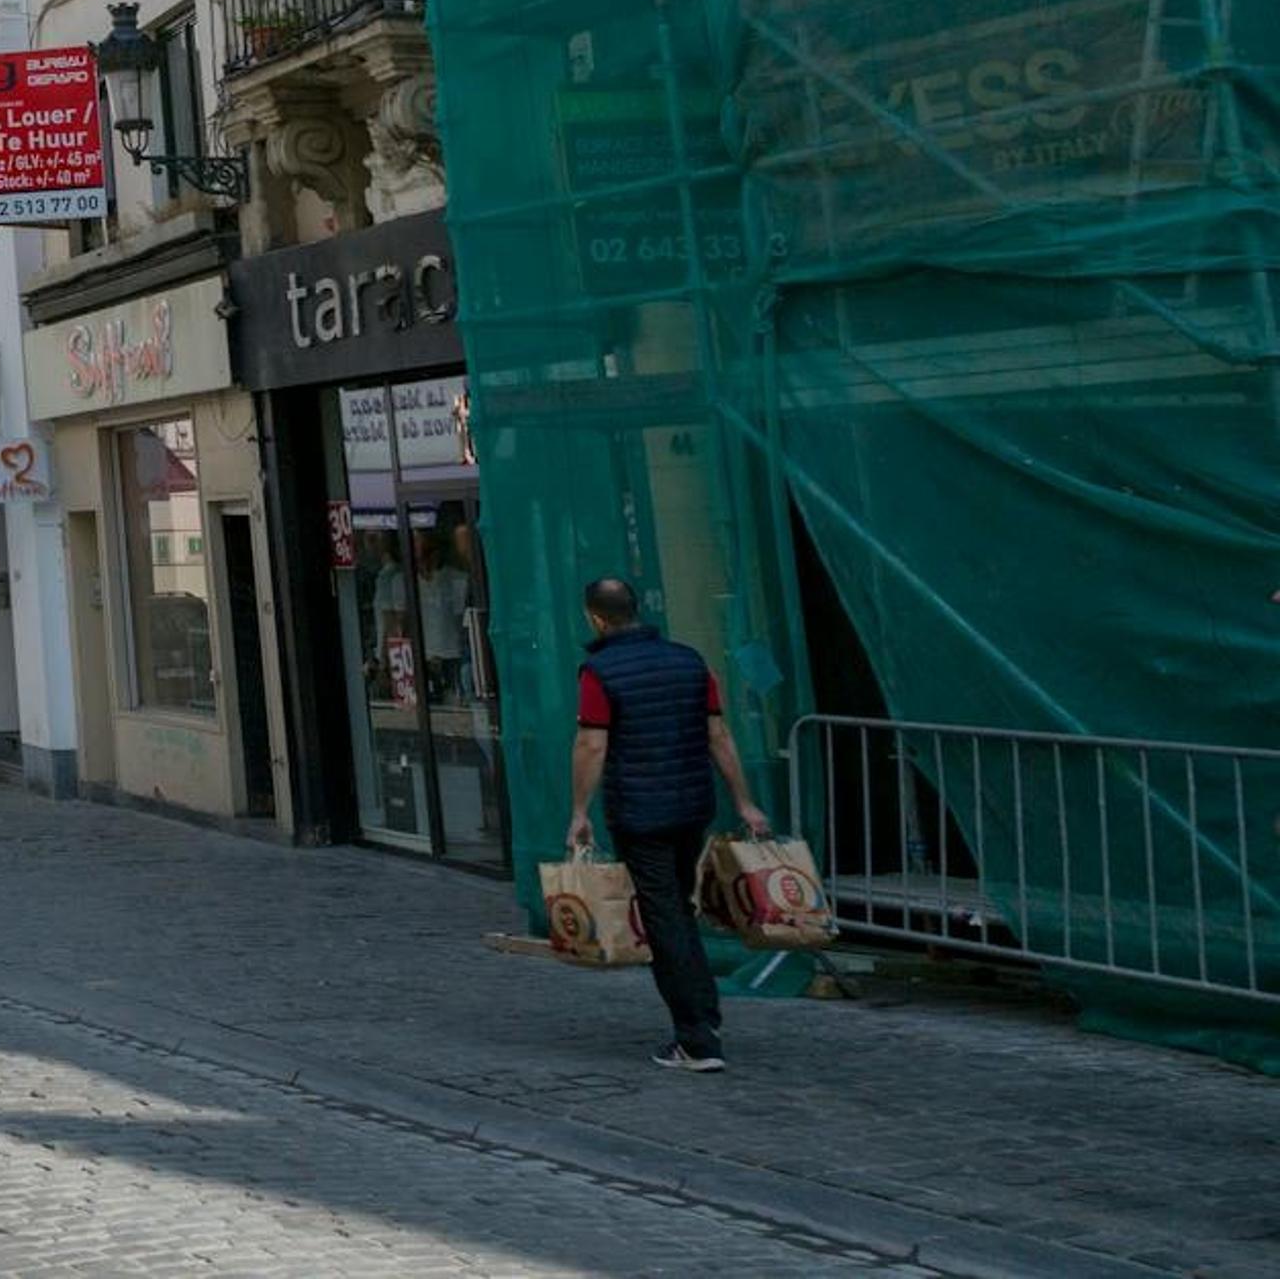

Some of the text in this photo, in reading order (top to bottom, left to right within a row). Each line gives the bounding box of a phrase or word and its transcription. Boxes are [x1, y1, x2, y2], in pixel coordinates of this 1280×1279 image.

[7, 107, 77, 128] Louer
[83, 102, 93, 124] /
[28, 130, 88, 149] Huur
[14, 198, 45, 216] 513
[50, 196, 71, 212] 77
[77, 195, 98, 211] 00
[329, 503, 351, 541] 30
[389, 640, 415, 680] 50
